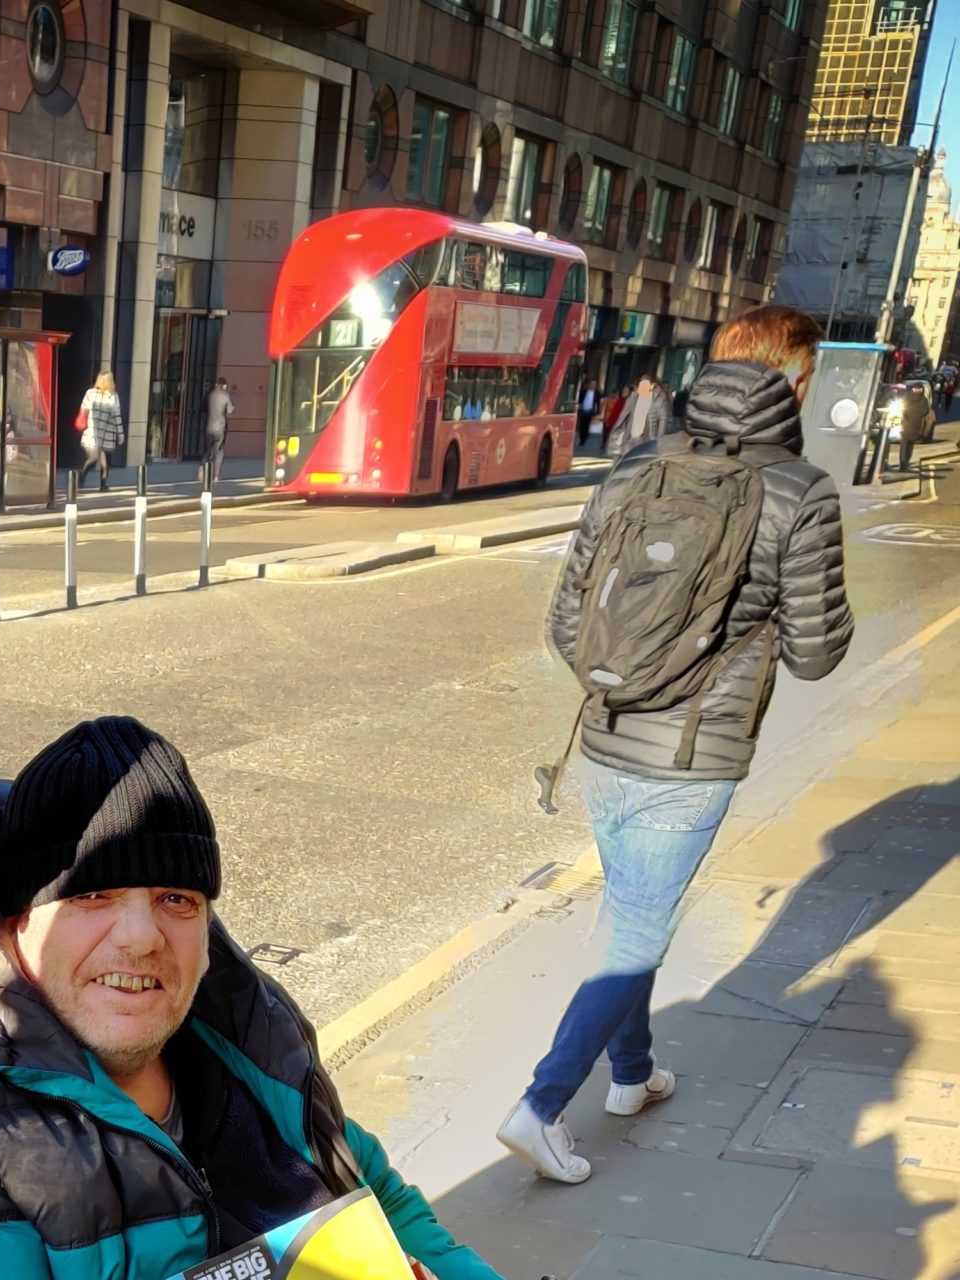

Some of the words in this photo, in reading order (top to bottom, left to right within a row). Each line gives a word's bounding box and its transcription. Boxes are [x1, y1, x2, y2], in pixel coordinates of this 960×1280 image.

[244, 219, 280, 241] 155
[335, 322, 352, 345] 21
[232, 1251, 267, 1280] BIG
